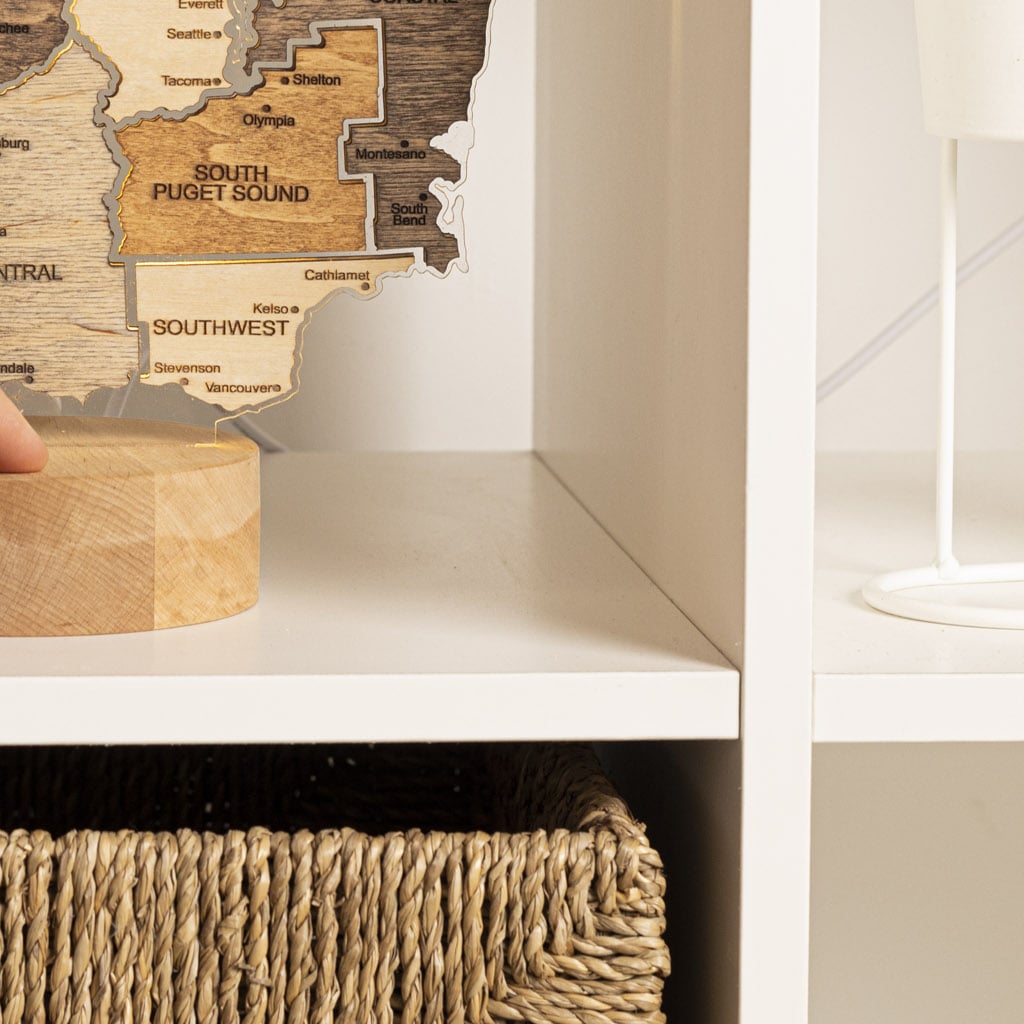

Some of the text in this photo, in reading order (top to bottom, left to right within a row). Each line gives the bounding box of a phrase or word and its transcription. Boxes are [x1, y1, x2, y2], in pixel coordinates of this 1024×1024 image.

[167, 28, 212, 40] Seattle
[161, 75, 212, 86] Tacoma
[293, 74, 341, 86] Shelton
[243, 114, 295, 129] Olympia
[355, 148, 426, 160] Montesano
[194, 165, 268, 182] SOUTH
[153, 183, 309, 203] PUGET SOUND
[391, 203, 428, 215] South
[393, 215, 426, 226] Bend
[304, 269, 370, 281] Cathlamet
[253, 303, 289, 314] Kelso
[153, 319, 289, 336] SOUTHWEST
[154, 362, 221, 374] Stevenson
[205, 382, 273, 393] Vancouver
